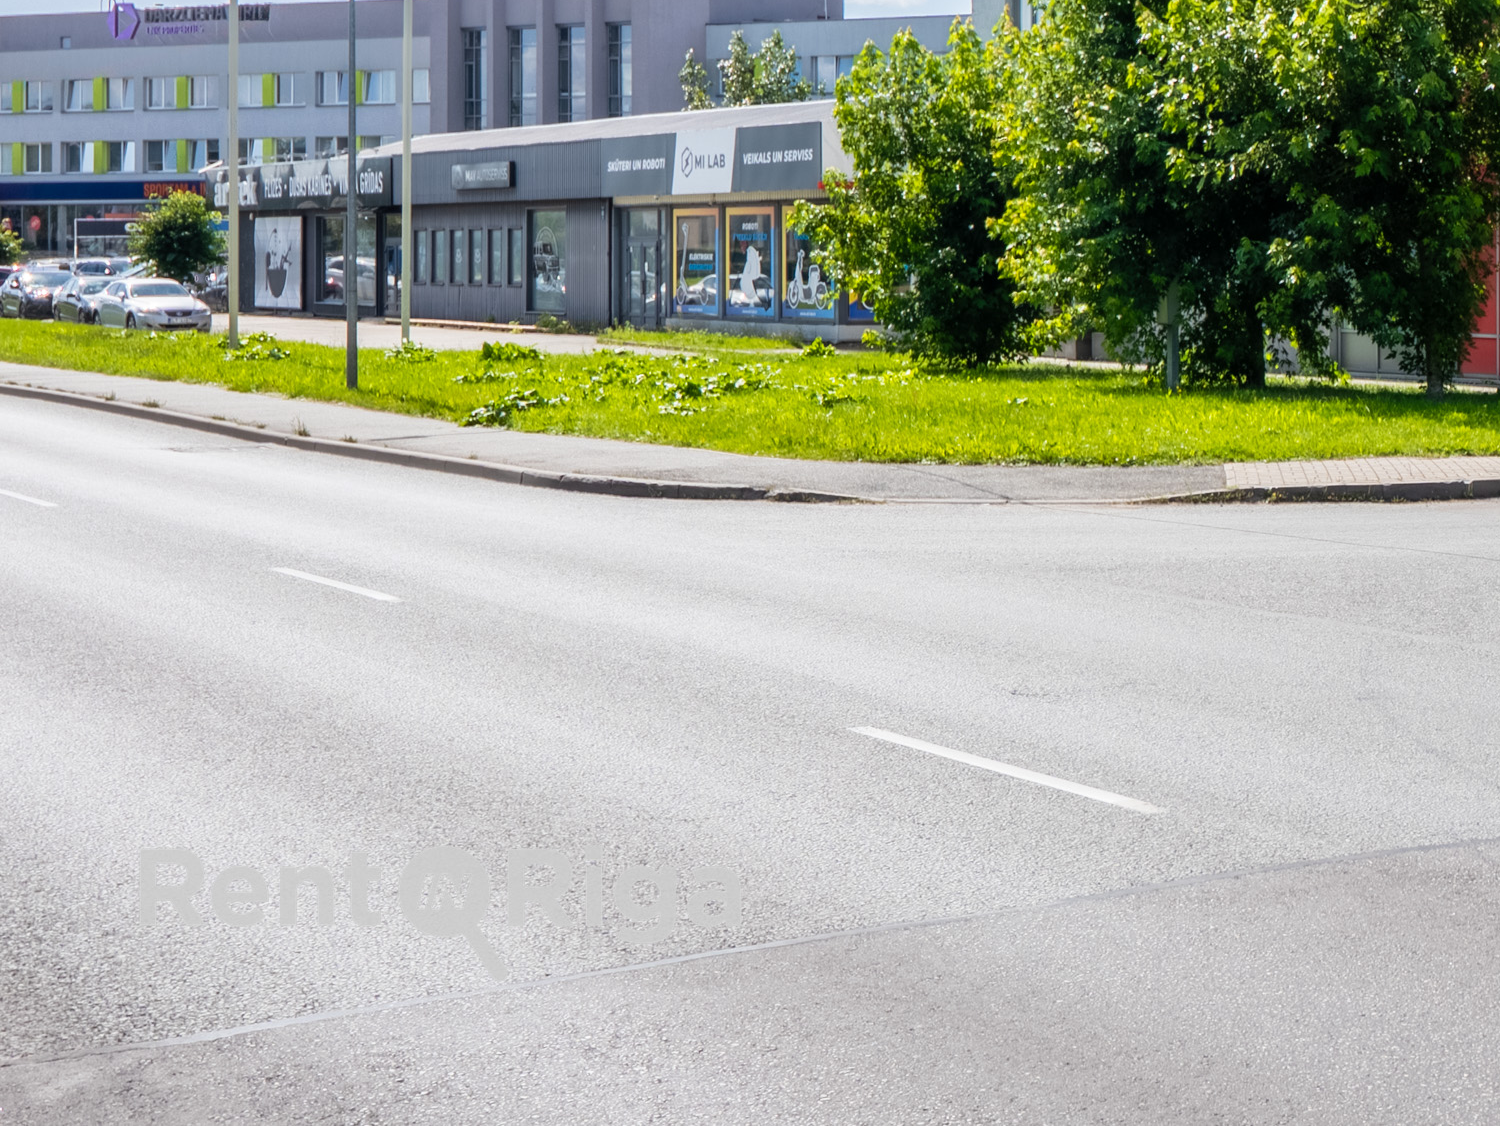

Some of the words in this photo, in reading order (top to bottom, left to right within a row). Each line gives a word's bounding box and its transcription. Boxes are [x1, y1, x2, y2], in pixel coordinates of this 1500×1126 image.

[632, 159, 642, 170] UN
[642, 157, 666, 170] ROBOTI
[695, 155, 705, 169] MI
[707, 154, 726, 168] LAB
[743, 152, 771, 165] VEIKALS
[772, 151, 783, 163] UN
[783, 148, 813, 162] SERVISS
[360, 168, 383, 194] GRĪDAS
